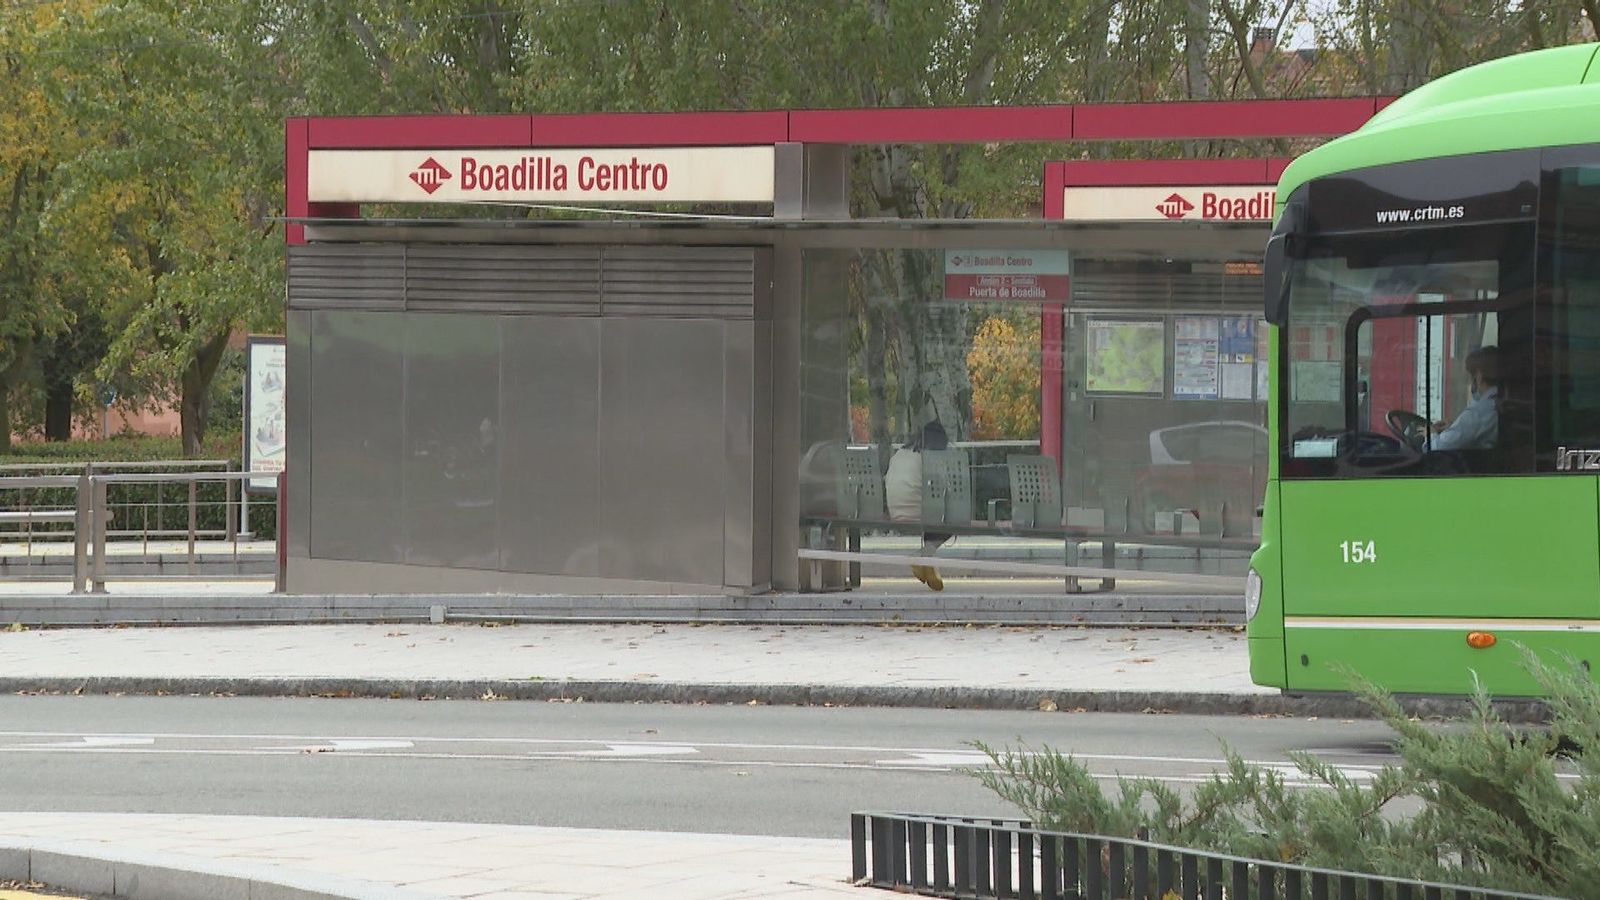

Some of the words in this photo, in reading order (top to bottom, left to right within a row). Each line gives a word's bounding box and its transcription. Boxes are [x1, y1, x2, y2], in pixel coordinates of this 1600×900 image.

[460, 156, 568, 191] Boadilla
[577, 156, 668, 191] Centro
[1376, 205, 1465, 223] www.crtm.es
[974, 256, 1005, 266] Boadilla
[1007, 256, 1032, 266] Centro
[969, 286, 997, 297] Puerta
[999, 286, 1009, 297] de
[1011, 286, 1046, 298] Boadilla
[1556, 446, 1600, 470] Iriz
[1340, 540, 1376, 563] 154
